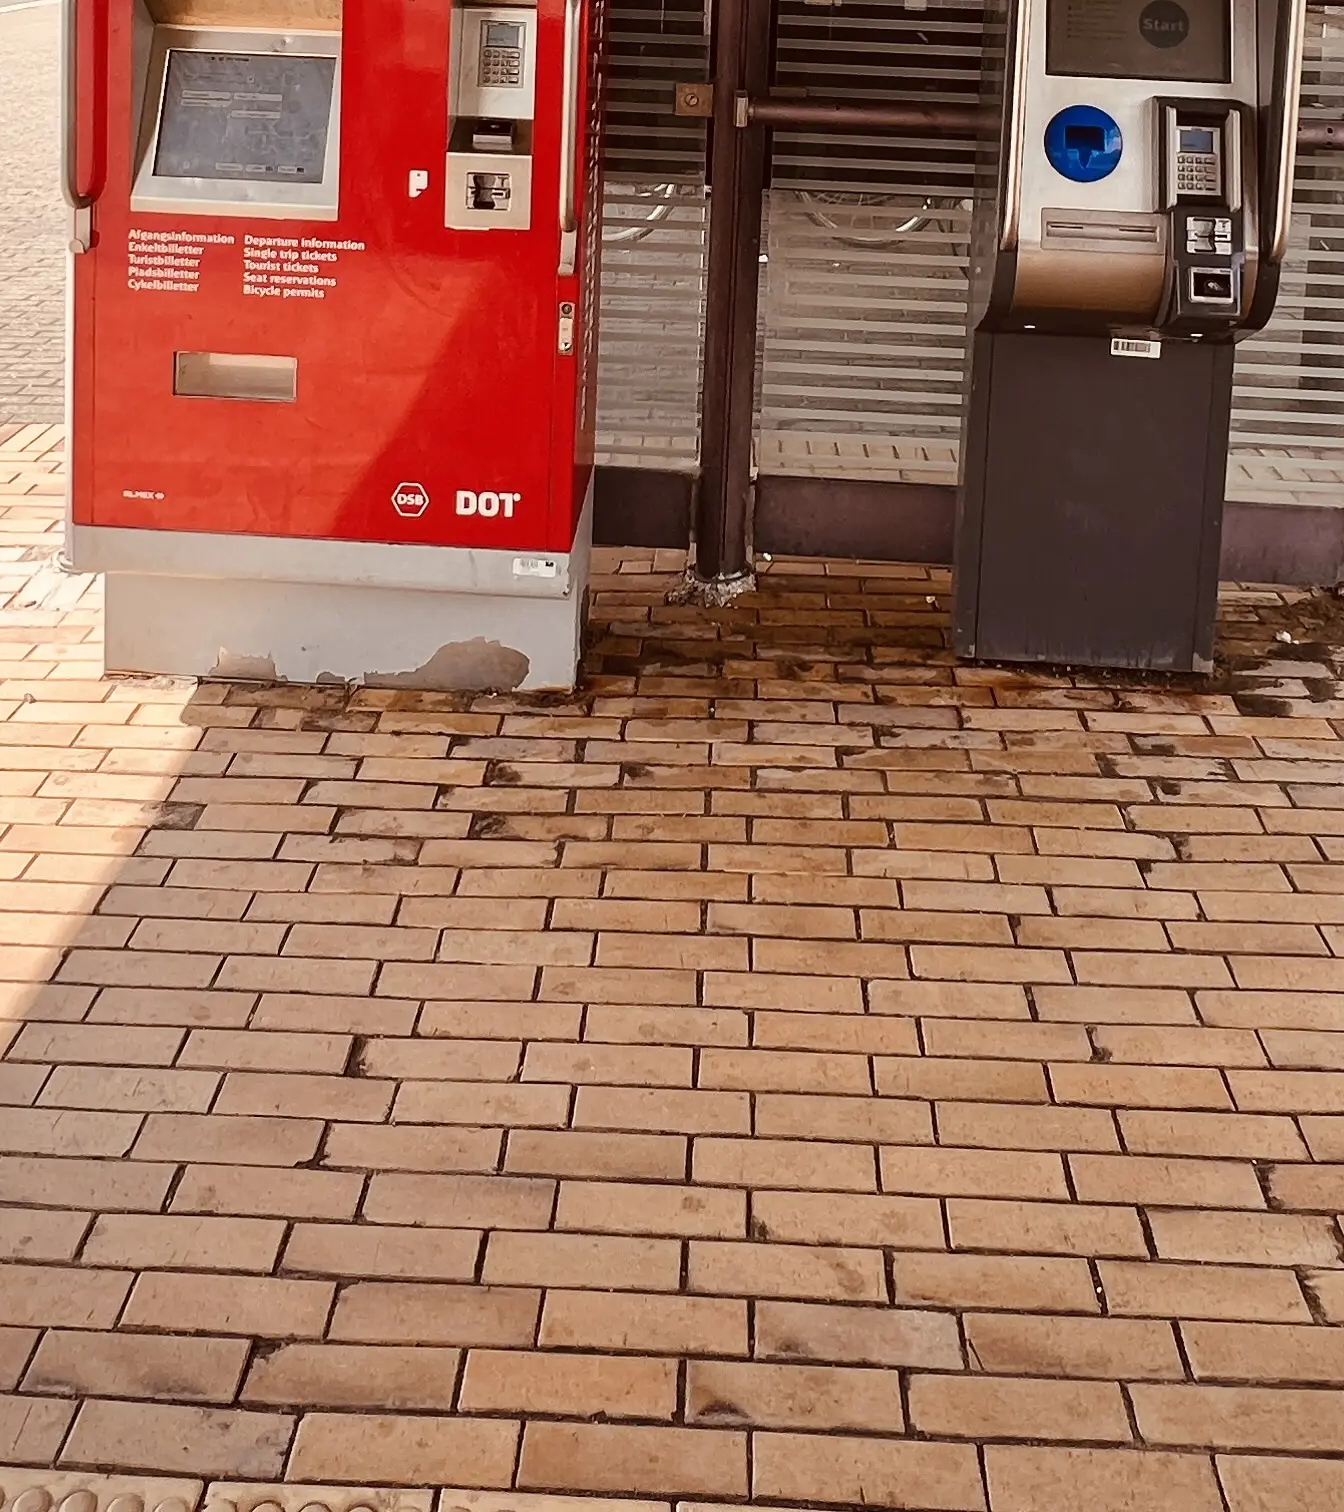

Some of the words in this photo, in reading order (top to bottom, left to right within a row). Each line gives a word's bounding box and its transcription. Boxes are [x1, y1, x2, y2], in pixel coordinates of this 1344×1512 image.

[128, 229, 235, 244] Afgangsinformation
[244, 235, 298, 248] Departure
[301, 238, 365, 251] information
[128, 242, 204, 255] Enkeltbilletter
[244, 248, 277, 259] Single
[280, 251, 299, 261] trip
[301, 251, 337, 261] tickets
[128, 254, 200, 267] Turistbilletter
[244, 260, 280, 271] Tourist
[283, 262, 319, 273] tickets
[128, 267, 200, 280] Pladsbilletter
[243, 272, 267, 283] Seat
[270, 275, 337, 287] reservations
[127, 279, 199, 292] Cykelbilletter
[243, 285, 280, 297] Bicycle
[283, 287, 325, 299] permits
[397, 493, 424, 505] DSB
[456, 490, 521, 518] DOT
